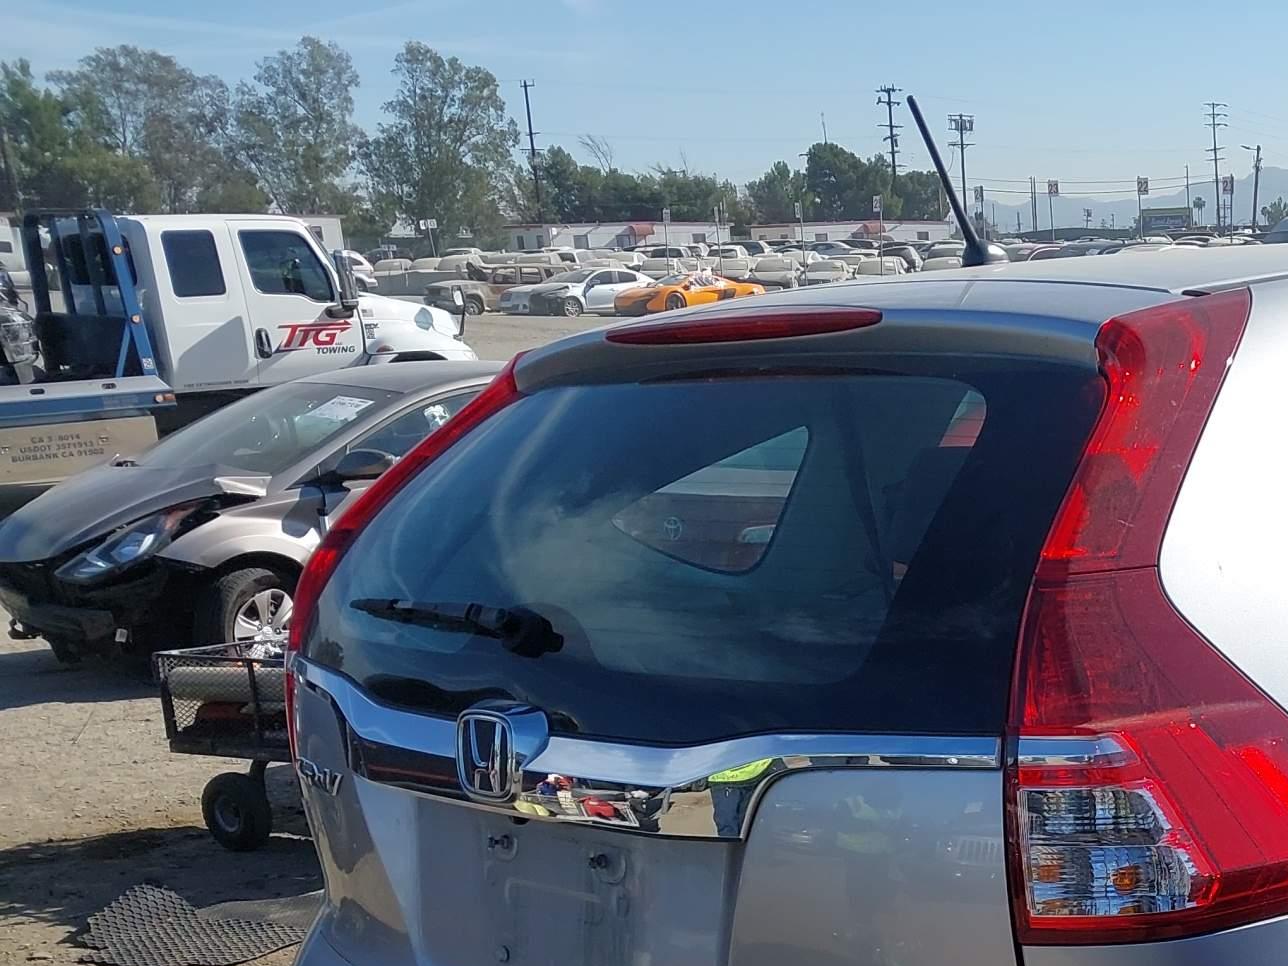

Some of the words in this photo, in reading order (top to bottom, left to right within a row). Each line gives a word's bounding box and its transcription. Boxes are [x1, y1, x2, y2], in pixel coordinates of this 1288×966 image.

[1047, 183, 1058, 194] 23
[1138, 180, 1148, 193] 22
[278, 321, 346, 348] TTG
[316, 346, 355, 354] TOWING
